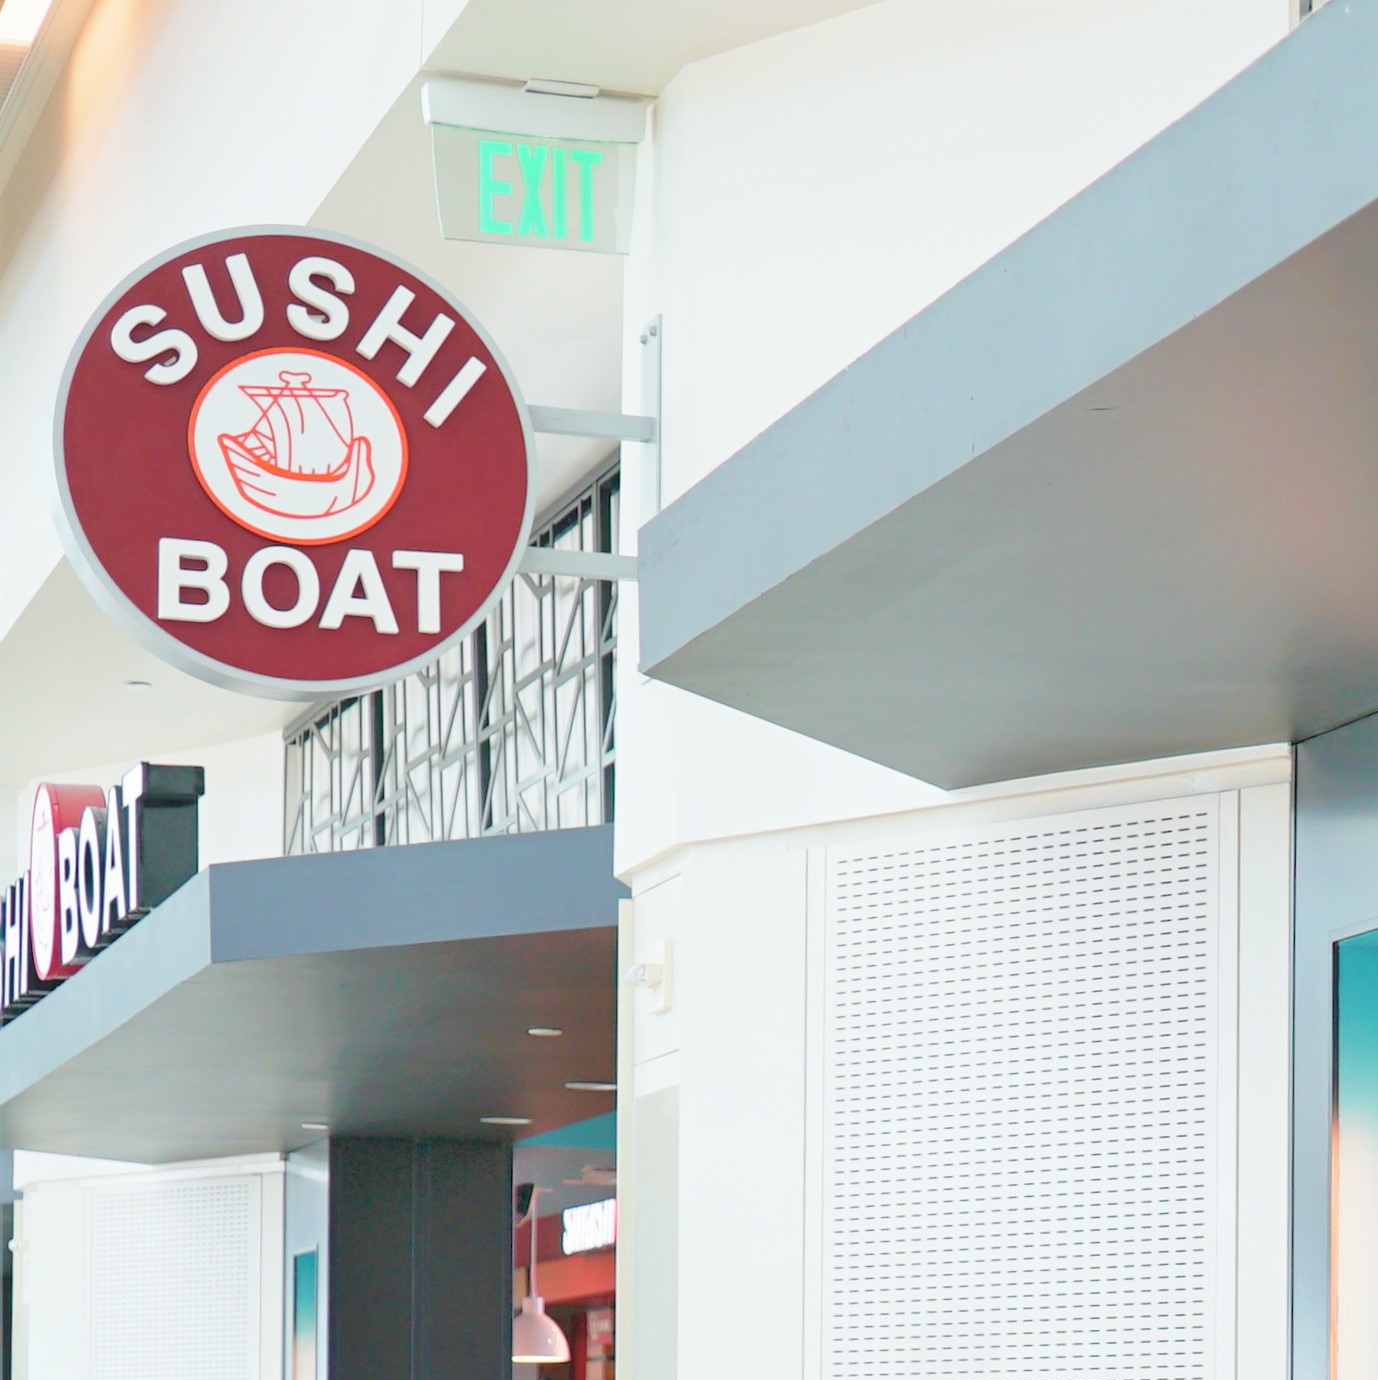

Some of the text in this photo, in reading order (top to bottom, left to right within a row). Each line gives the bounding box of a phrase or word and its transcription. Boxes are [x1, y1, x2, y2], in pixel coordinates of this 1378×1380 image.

[478, 139, 602, 242] EXIT
[111, 253, 486, 428] SUSHI
[158, 538, 464, 634] BOAT
[59, 762, 143, 966] BOAT
